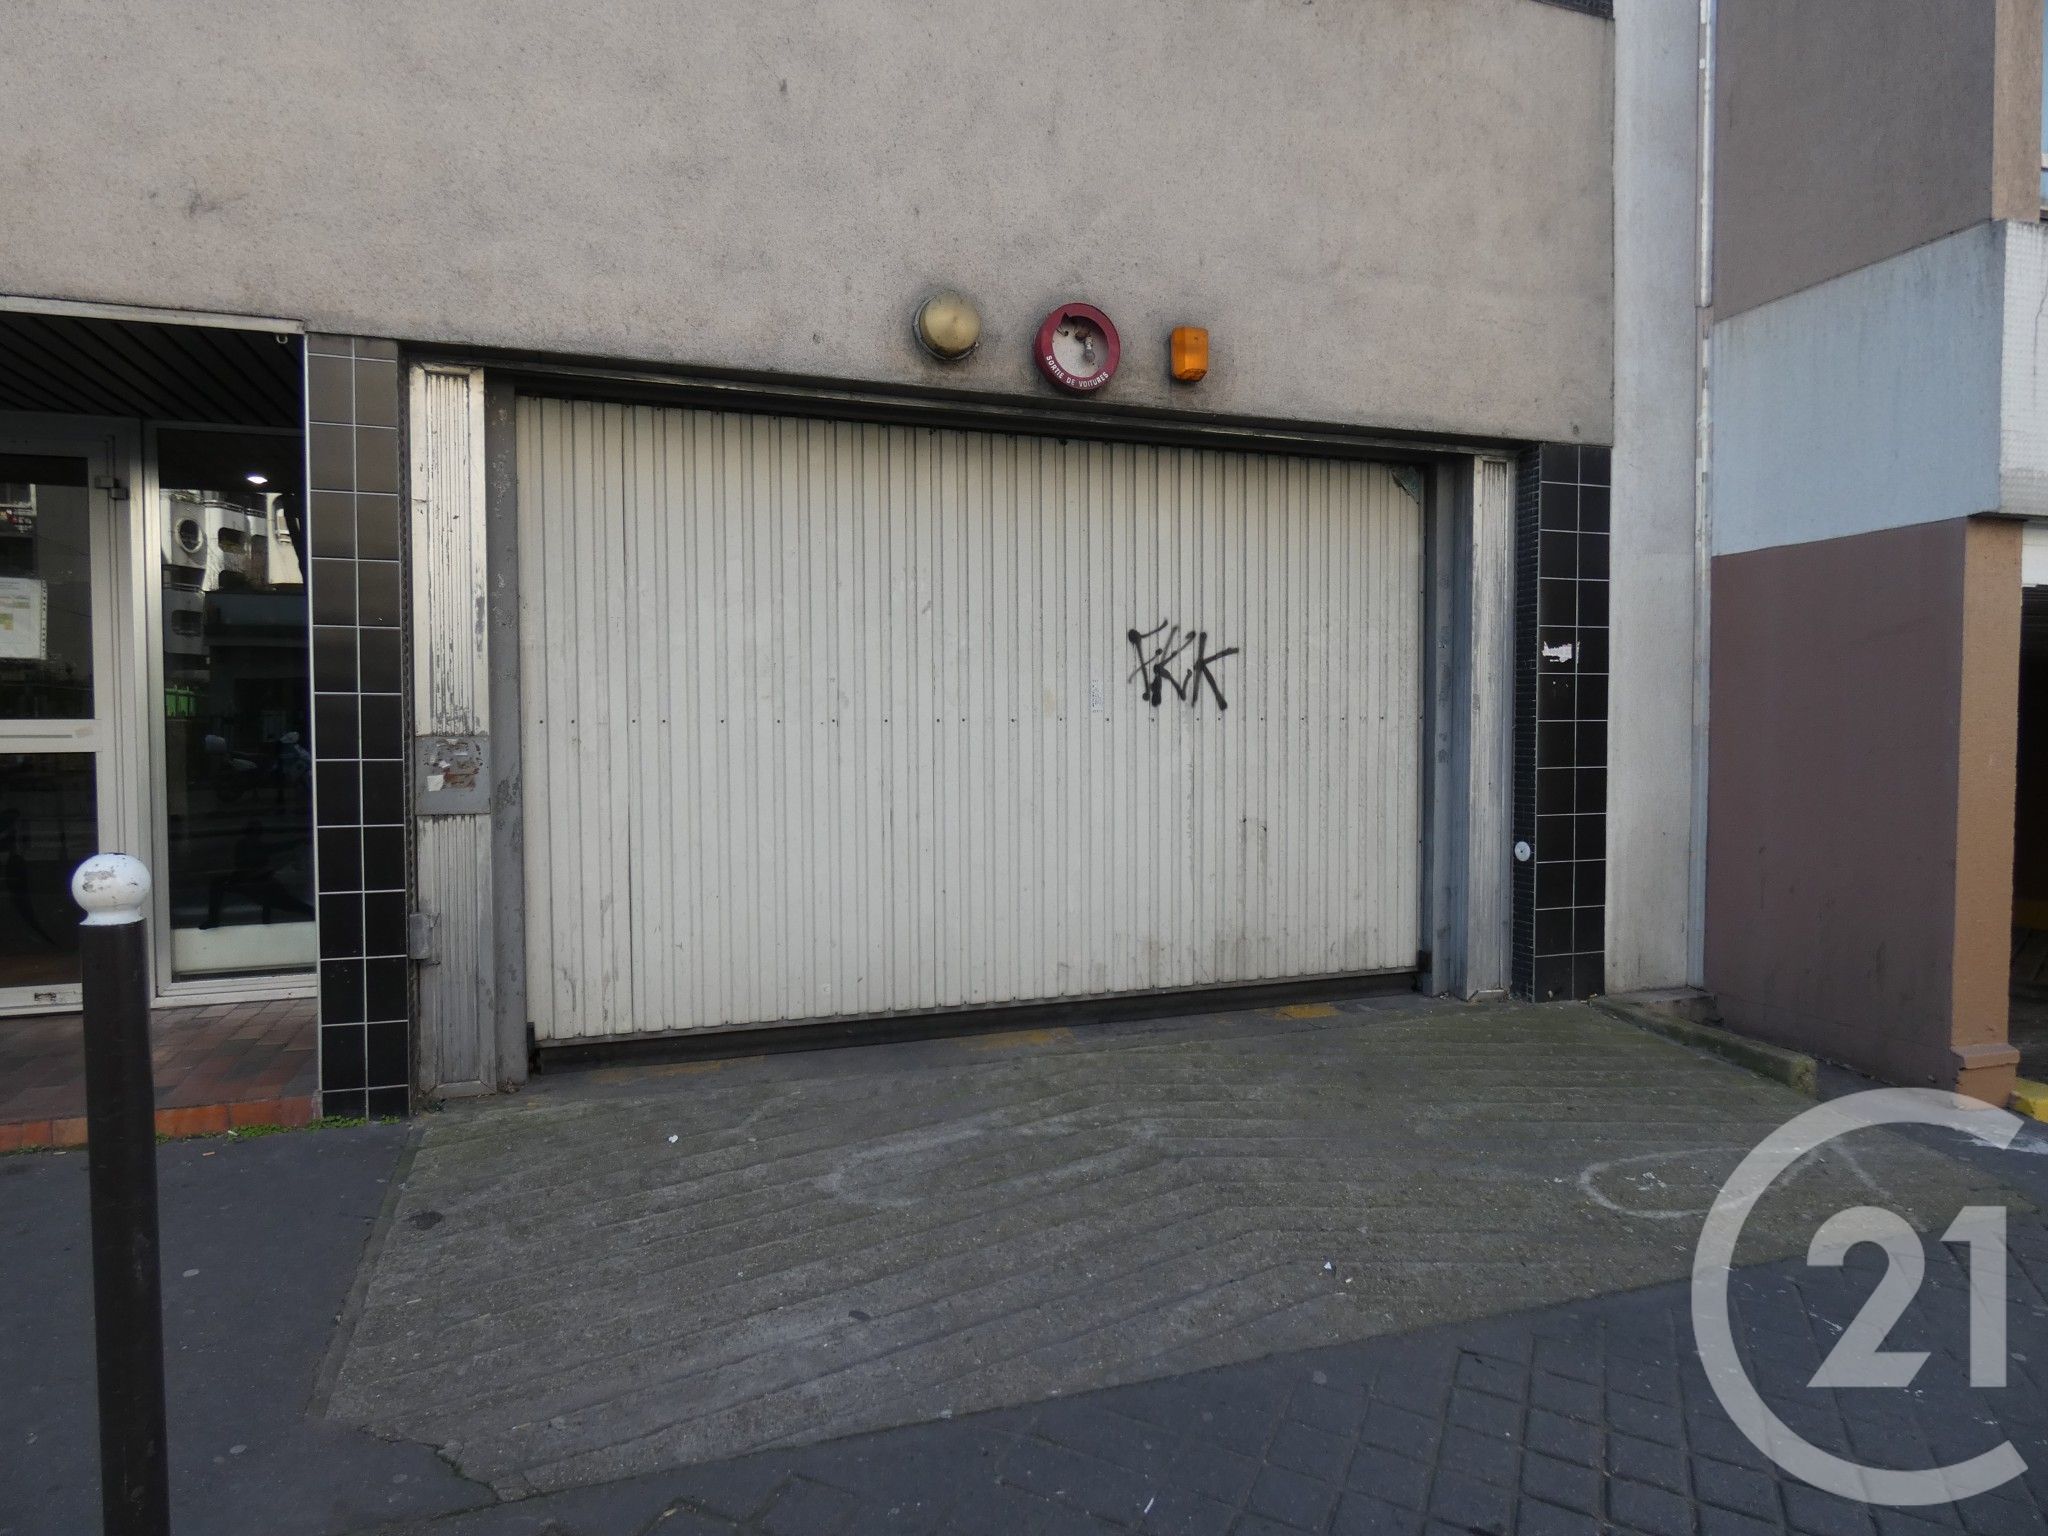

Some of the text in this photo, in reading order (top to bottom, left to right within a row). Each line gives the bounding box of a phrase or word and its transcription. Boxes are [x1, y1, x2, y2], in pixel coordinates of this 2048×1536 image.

[1046, 355, 1109, 388] SORTIE DE VOITURES
